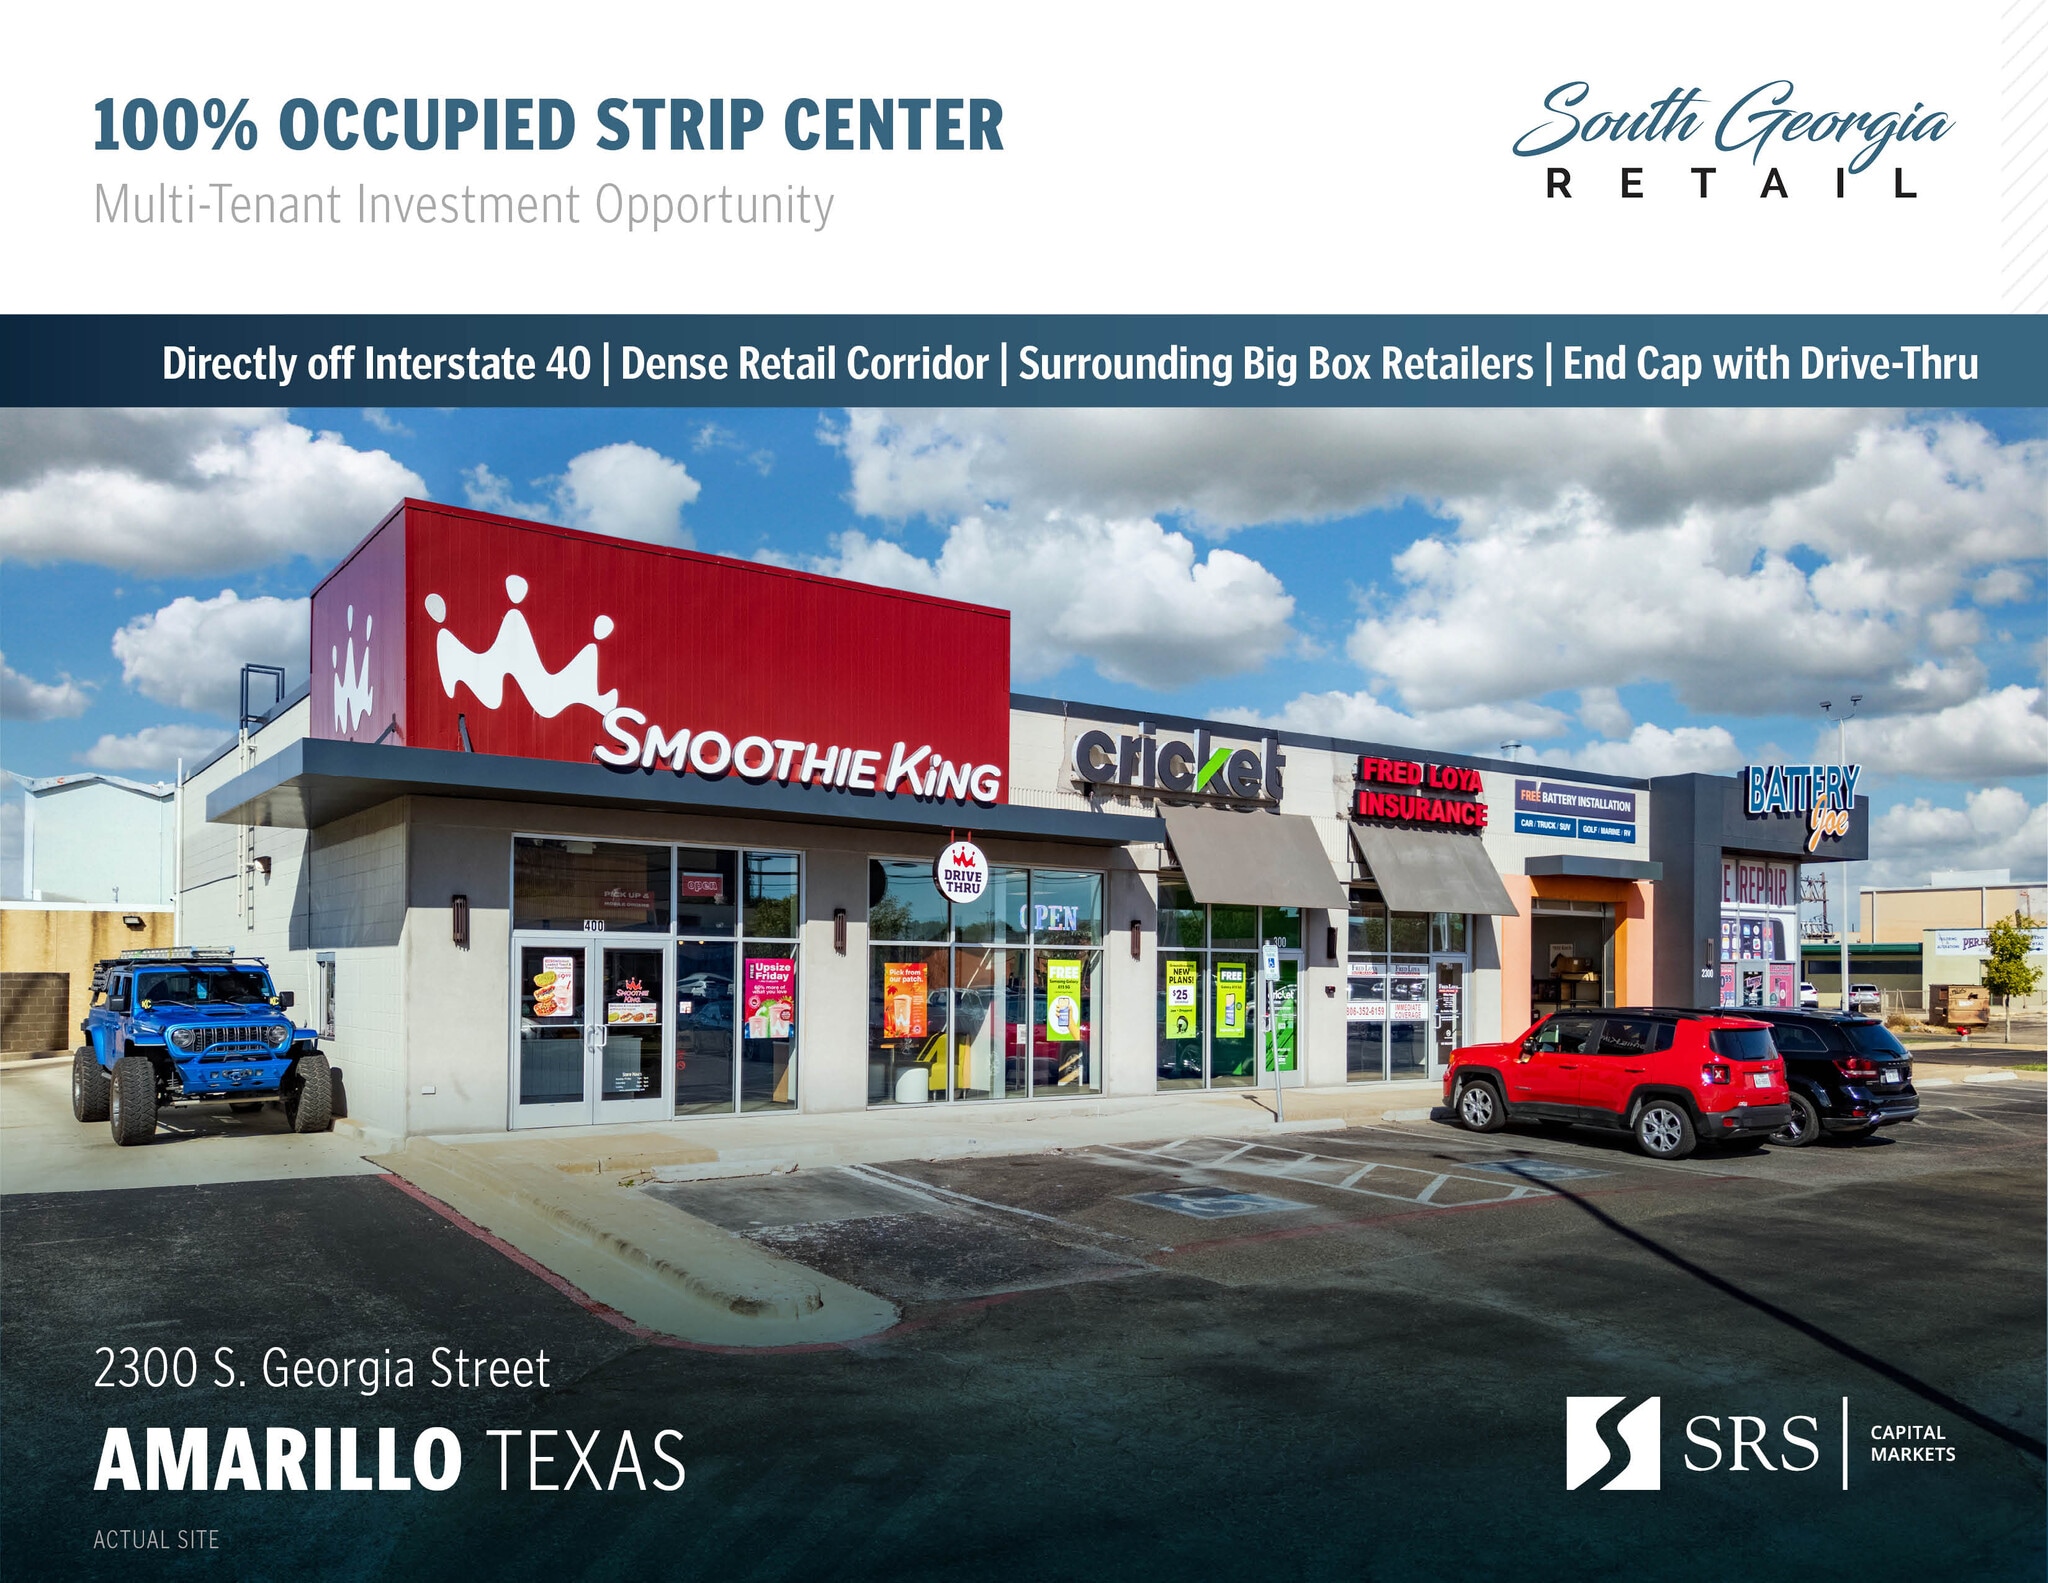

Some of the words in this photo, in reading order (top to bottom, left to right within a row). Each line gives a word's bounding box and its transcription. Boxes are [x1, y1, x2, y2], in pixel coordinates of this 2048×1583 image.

[594, 706, 881, 790] SMOOTHIE
[1072, 721, 1286, 800] cricket
[1364, 757, 1422, 786] FRED
[1428, 765, 1484, 793] LOYA
[1749, 764, 1861, 813] BATTERY
[1521, 789, 1541, 802] FREE
[1542, 792, 1577, 806] BATTERY
[1578, 796, 1631, 812] INSTALLATION
[1360, 791, 1489, 827] INSURANCE
[1521, 819, 1534, 827] CAR
[1537, 821, 1556, 830] TRUCK
[1560, 823, 1571, 831] SUV
[1809, 793, 1849, 852] Joe
[1583, 825, 1597, 834] GOLF
[1601, 827, 1620, 836] MARINE
[1624, 829, 1631, 837] RV
[944, 869, 982, 883] DRIVE
[688, 881, 718, 892] open
[946, 881, 980, 894] THRU
[1019, 904, 1079, 931] OPEN
[585, 920, 603, 931] 400
[1274, 936, 1287, 948] 300
[755, 963, 791, 973] Upsize
[1049, 966, 1079, 979] FREE
[1173, 968, 1190, 976] NEW
[1701, 969, 1714, 978] 2300
[755, 972, 789, 982] Friday
[1169, 976, 1194, 984] PLANS!
[1221, 971, 1242, 981] FREE
[1172, 989, 1188, 1000] $25
[141, 999, 151, 1009] KC
[270, 997, 279, 1006] KC
